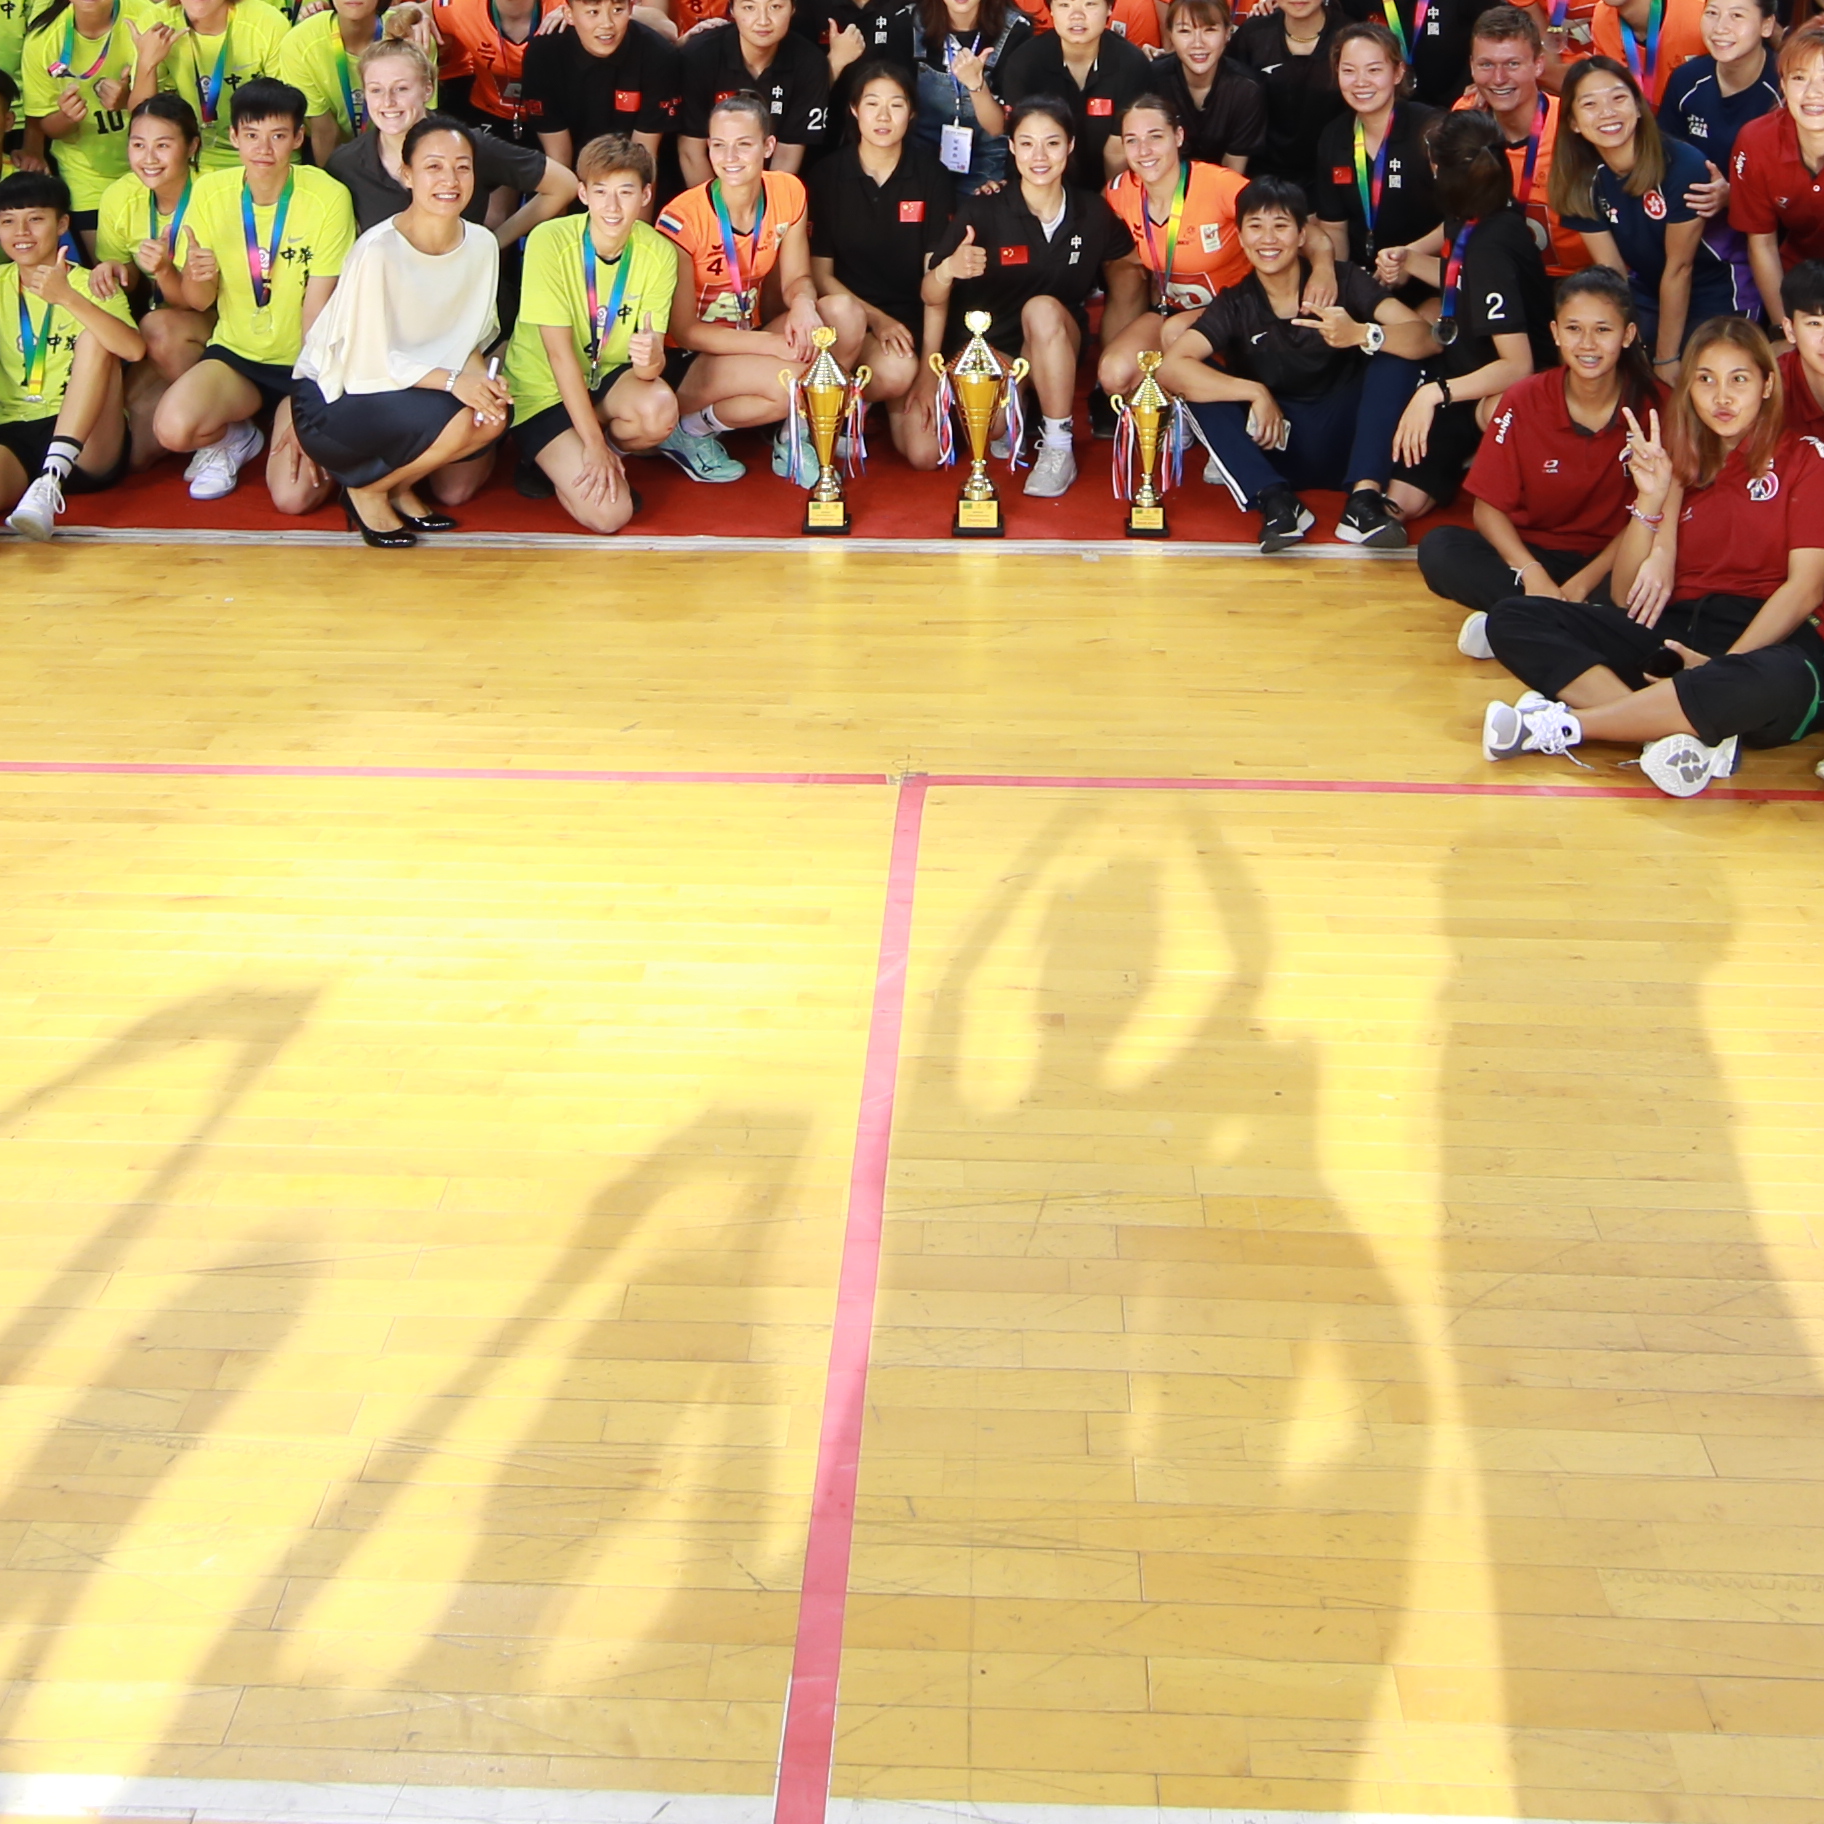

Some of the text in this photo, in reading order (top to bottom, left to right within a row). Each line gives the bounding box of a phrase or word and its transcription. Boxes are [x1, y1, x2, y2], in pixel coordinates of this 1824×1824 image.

[95, 110, 126, 135] 10
[706, 257, 724, 276] 4
[1486, 292, 1506, 320] 2
